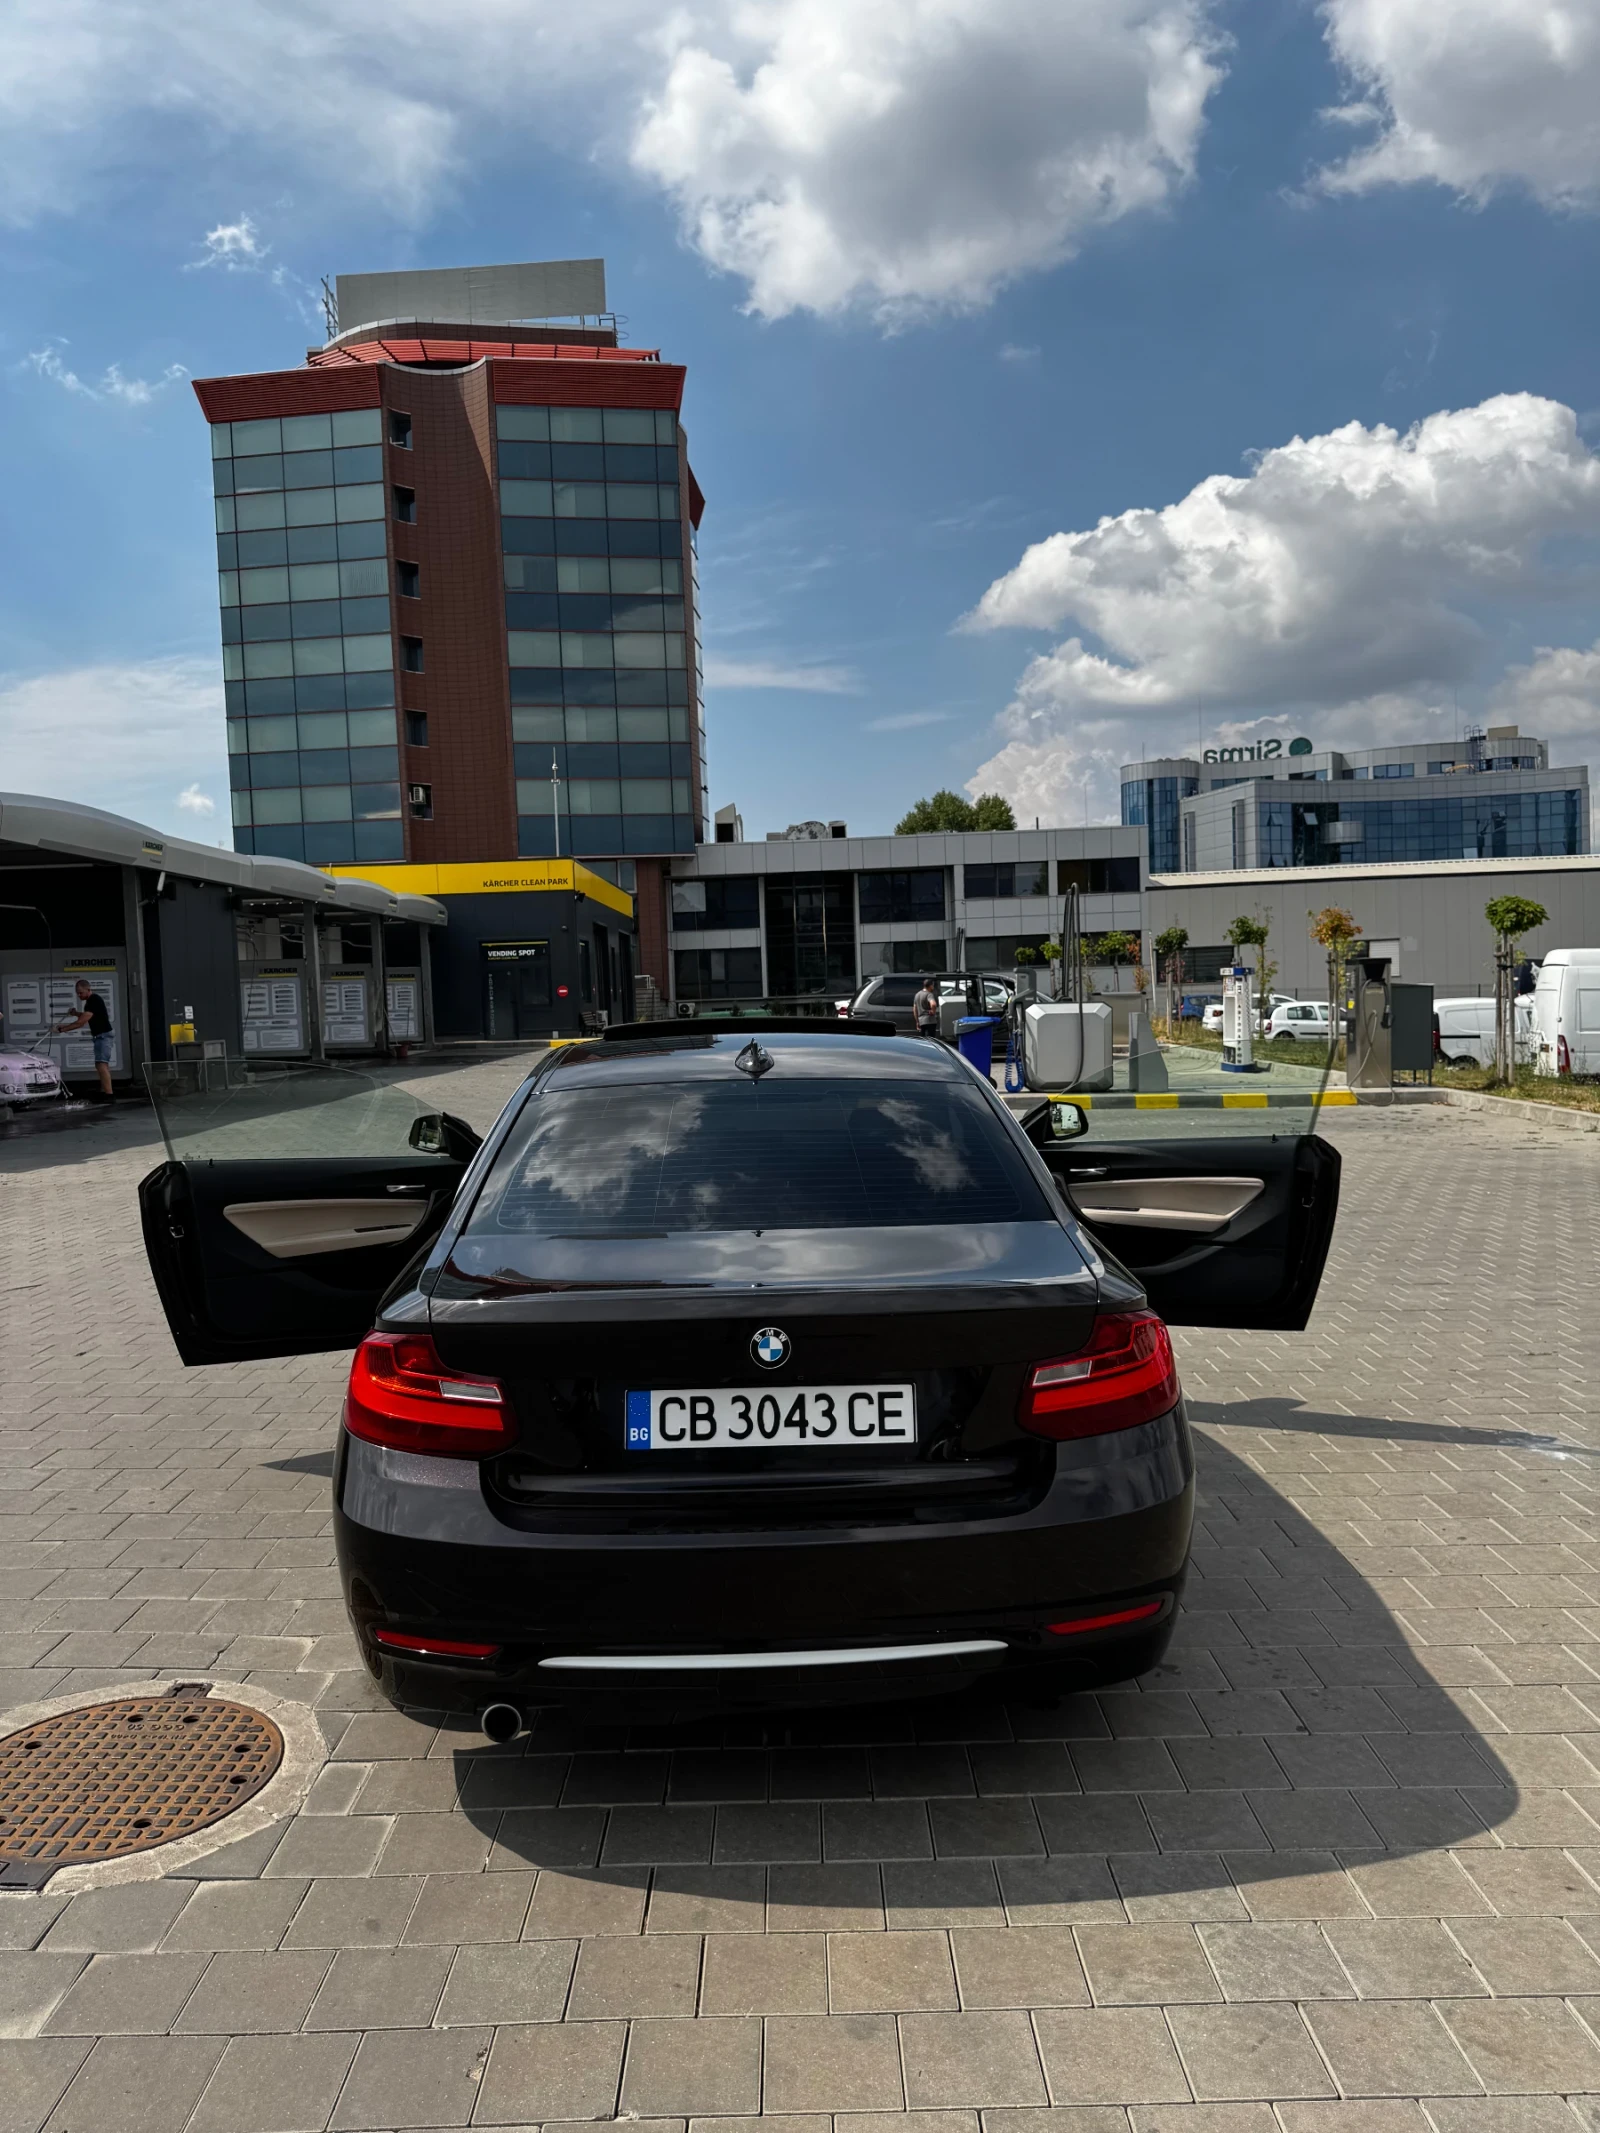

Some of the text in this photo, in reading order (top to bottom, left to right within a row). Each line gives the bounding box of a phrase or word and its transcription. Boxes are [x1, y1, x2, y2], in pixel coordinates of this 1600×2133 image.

[483, 877, 569, 888] KÄRCHER CLEAN PARK
[753, 1328, 787, 1343] BMW
[658, 1391, 906, 1443] CB 3043 CE
[629, 1427, 649, 1442] BG
